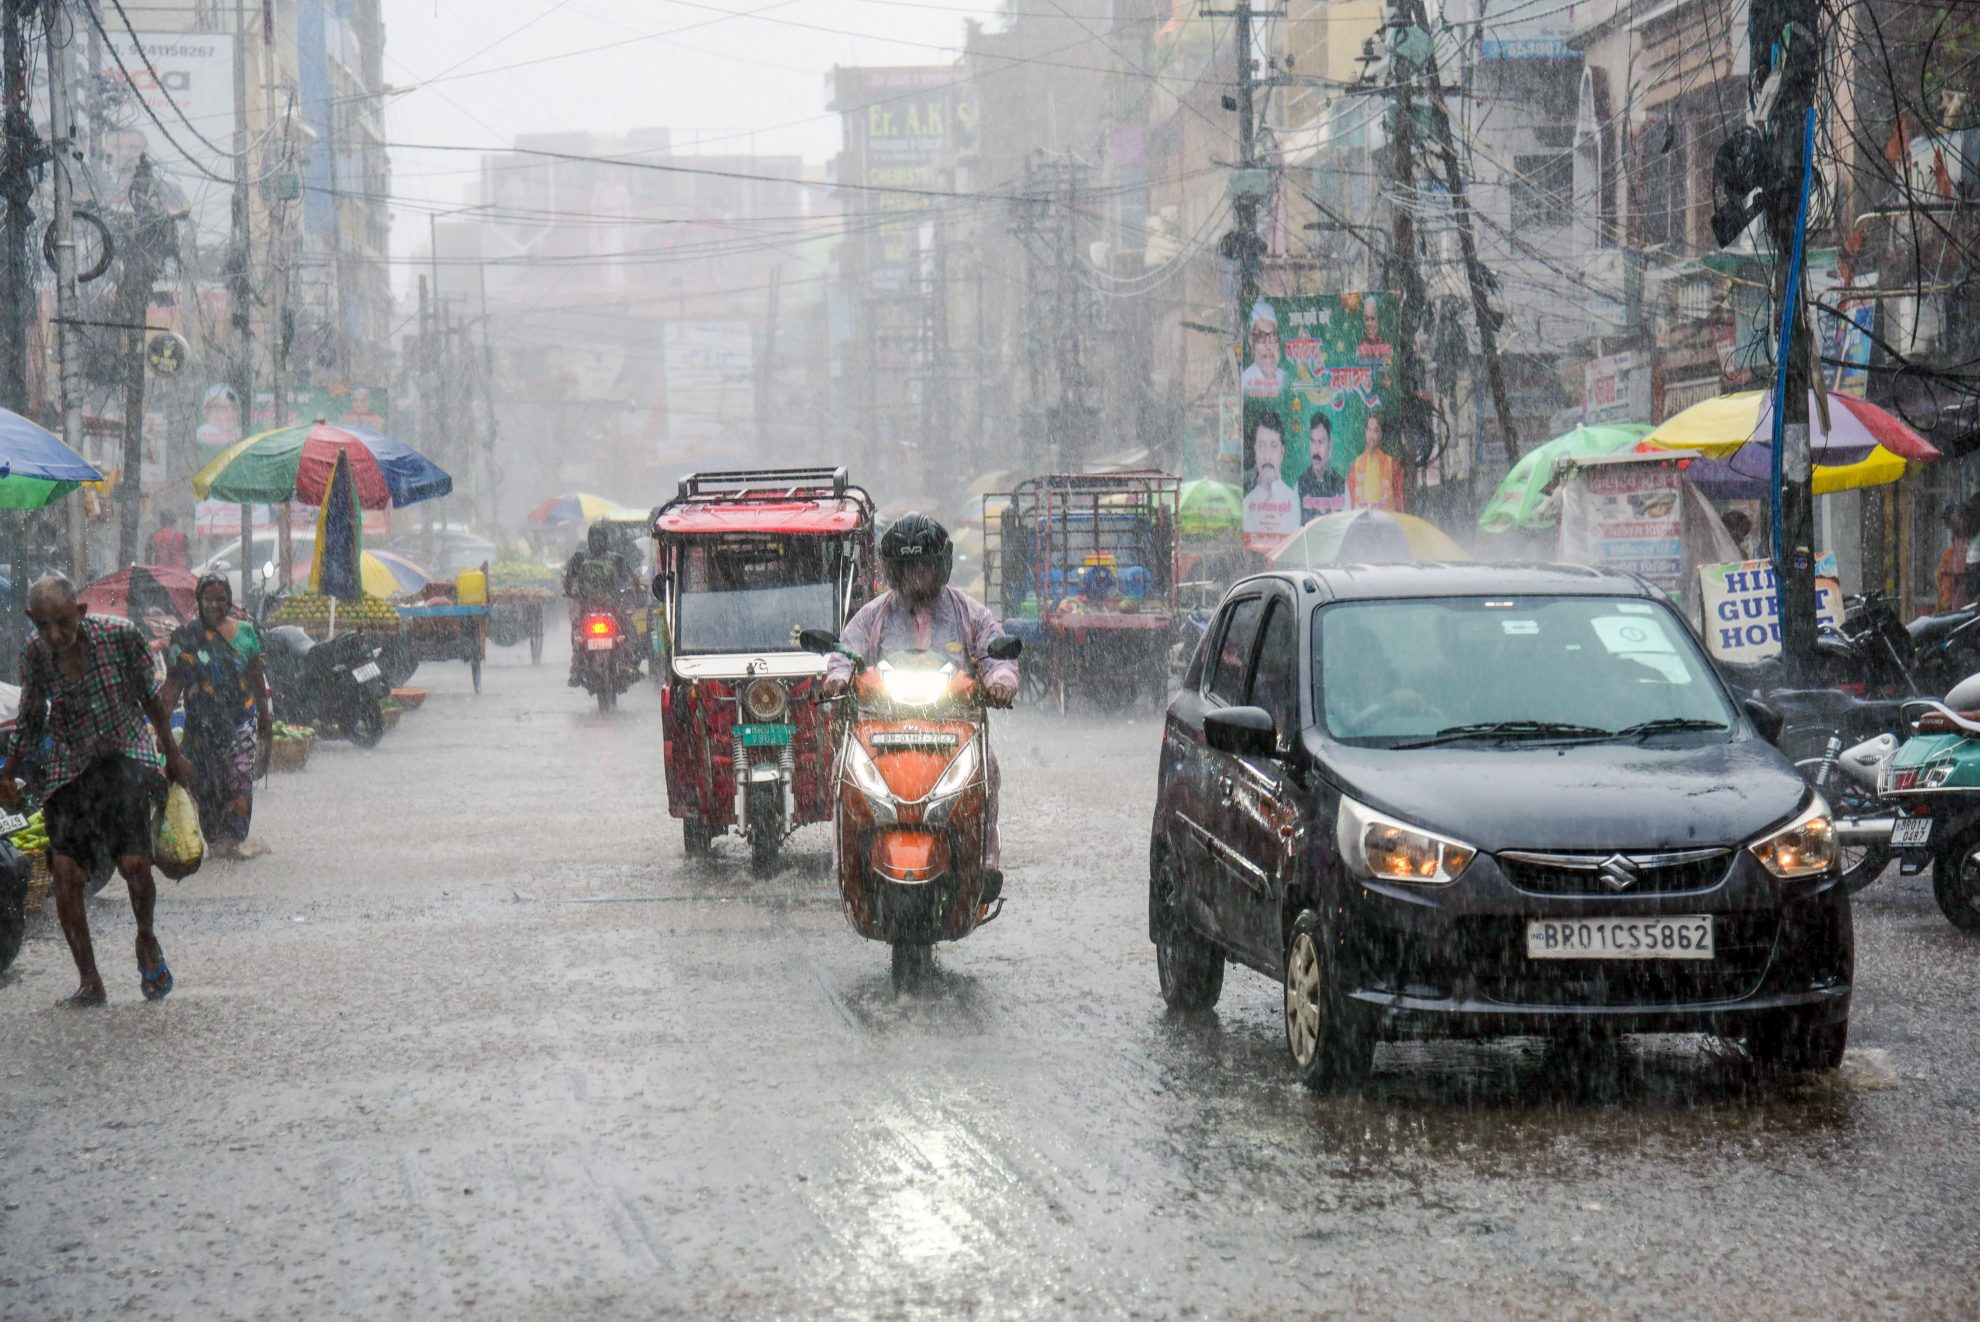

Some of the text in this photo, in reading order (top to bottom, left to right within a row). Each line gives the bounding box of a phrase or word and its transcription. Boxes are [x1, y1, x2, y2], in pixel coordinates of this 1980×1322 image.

[1903, 831, 1925, 841] 0487
[1531, 924, 1709, 950] IND BR01CS5862
